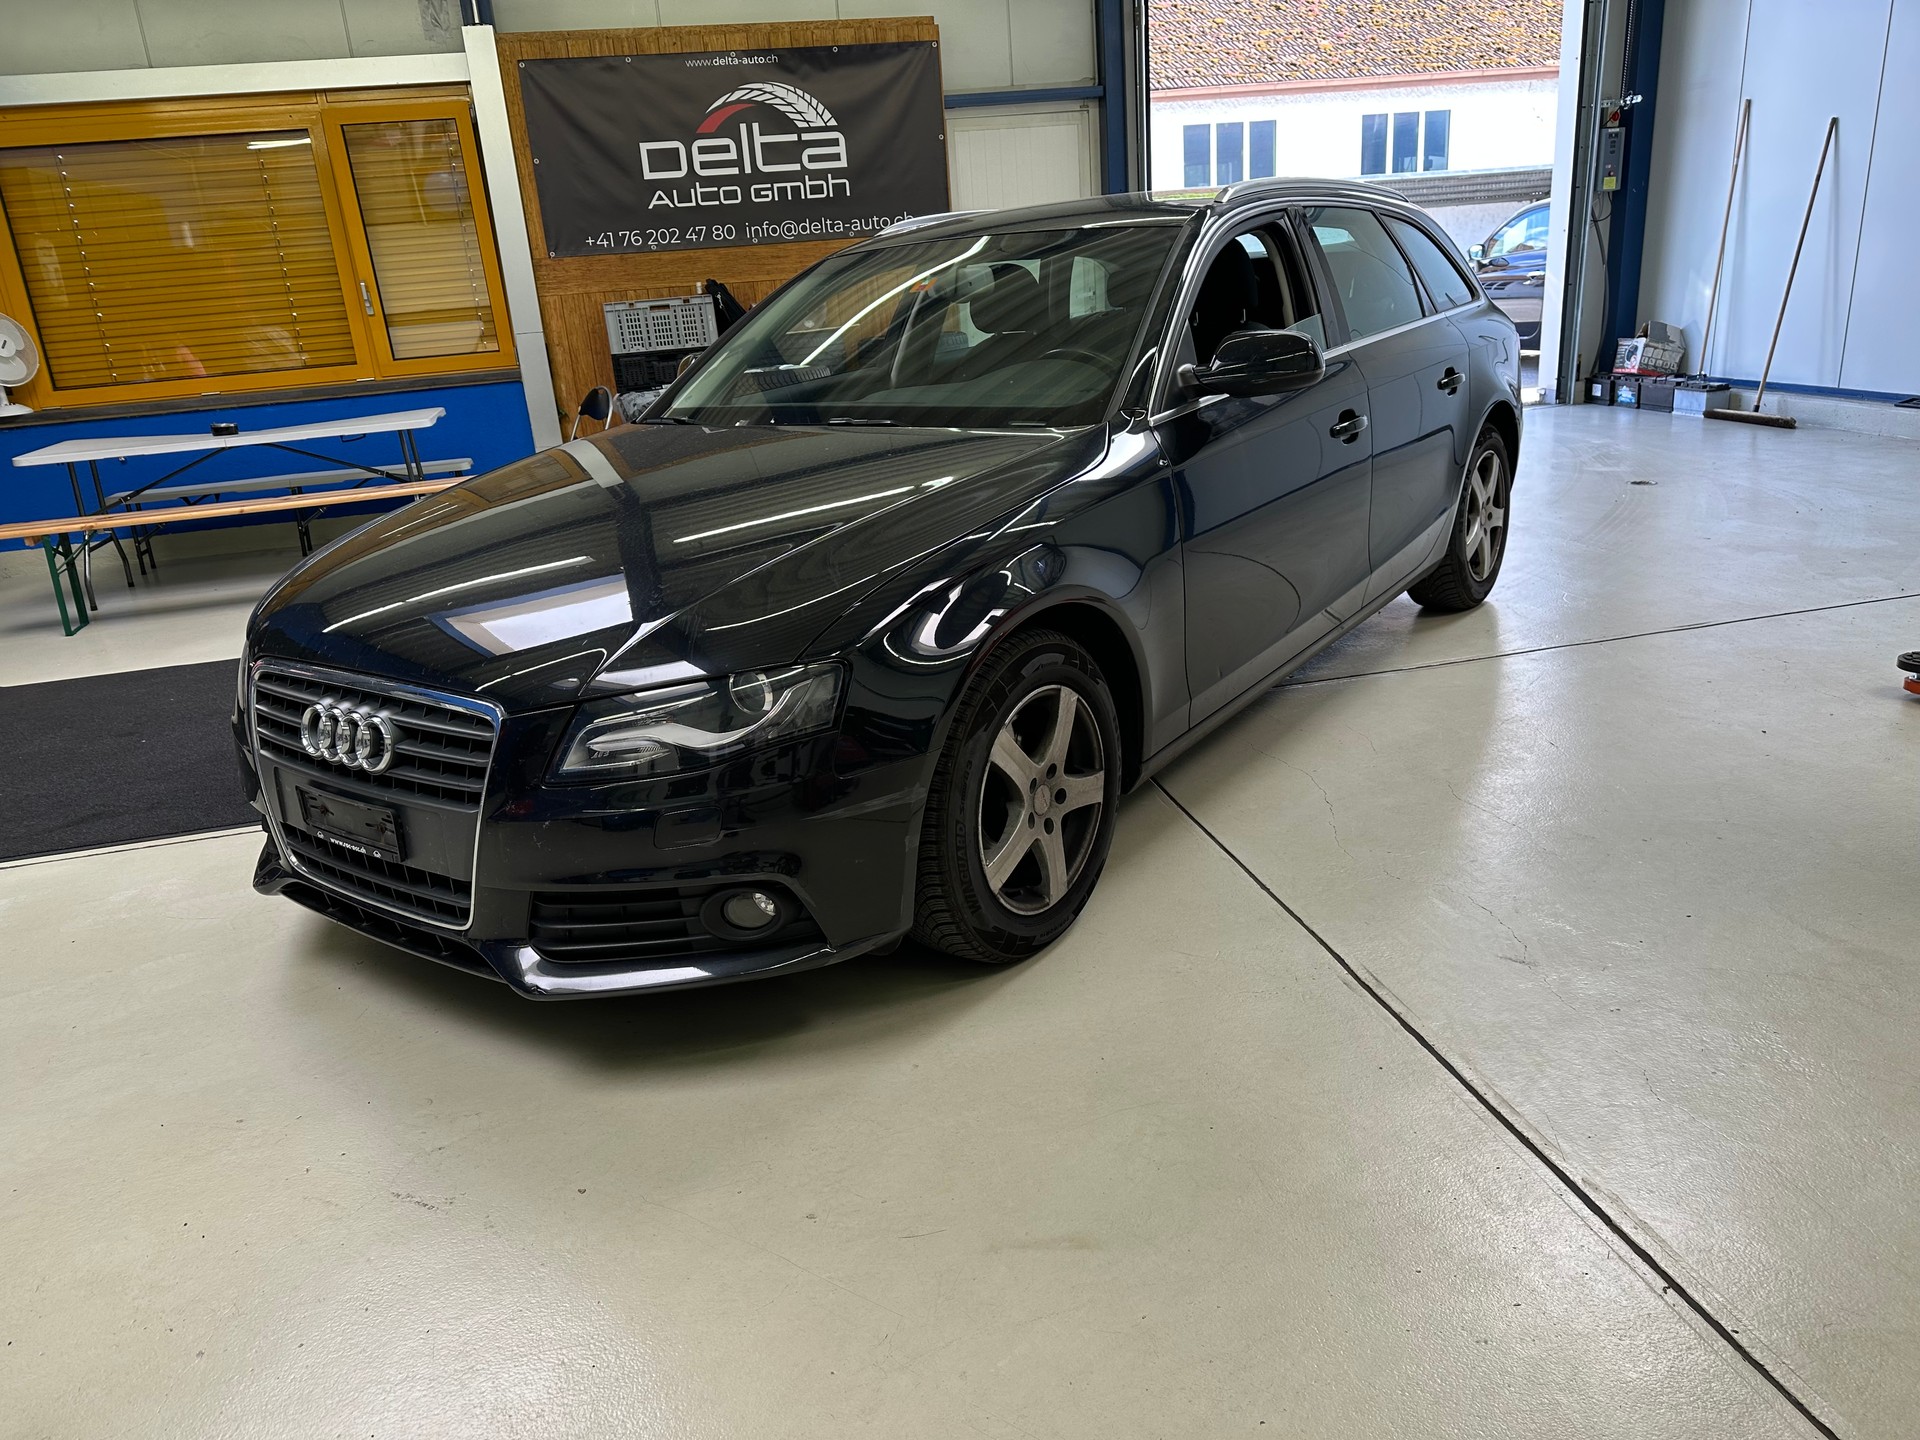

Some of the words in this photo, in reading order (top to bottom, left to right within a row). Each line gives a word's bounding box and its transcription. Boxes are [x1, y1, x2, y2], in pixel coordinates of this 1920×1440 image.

[684, 53, 780, 68] www.delta-auto.ch
[638, 122, 848, 180] Delta
[585, 231, 615, 248] +41
[618, 230, 643, 247] 76
[646, 227, 682, 246] 202
[686, 225, 707, 242] 47
[712, 223, 737, 241] 80
[745, 211, 915, 241] info@delta-autoch
